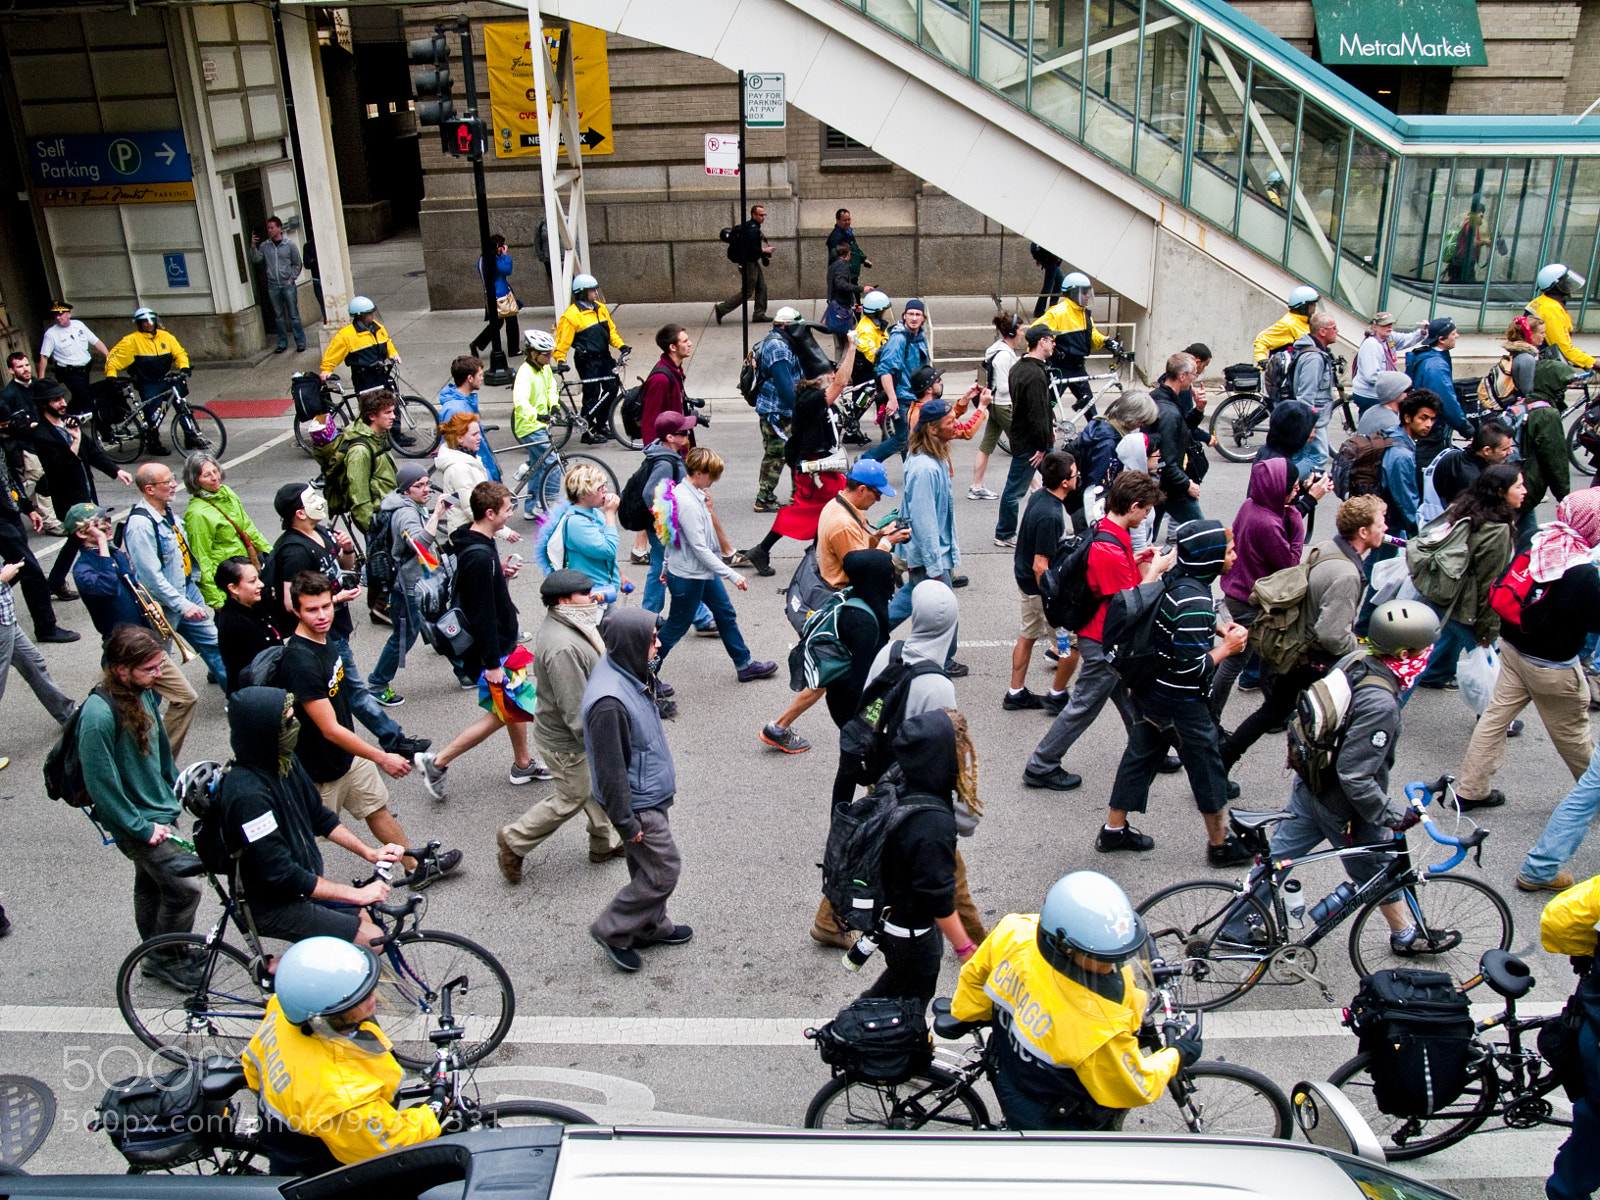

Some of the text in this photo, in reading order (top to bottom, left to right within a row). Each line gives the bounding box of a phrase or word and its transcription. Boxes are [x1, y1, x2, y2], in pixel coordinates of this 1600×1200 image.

[1340, 32, 1471, 57] MetraMarket
[36, 139, 66, 158] Self
[41, 161, 100, 182] Parking
[154, 190, 189, 199] PARKING
[994, 960, 1052, 1038] CHICAGO
[258, 1011, 291, 1094] CHICAGO
